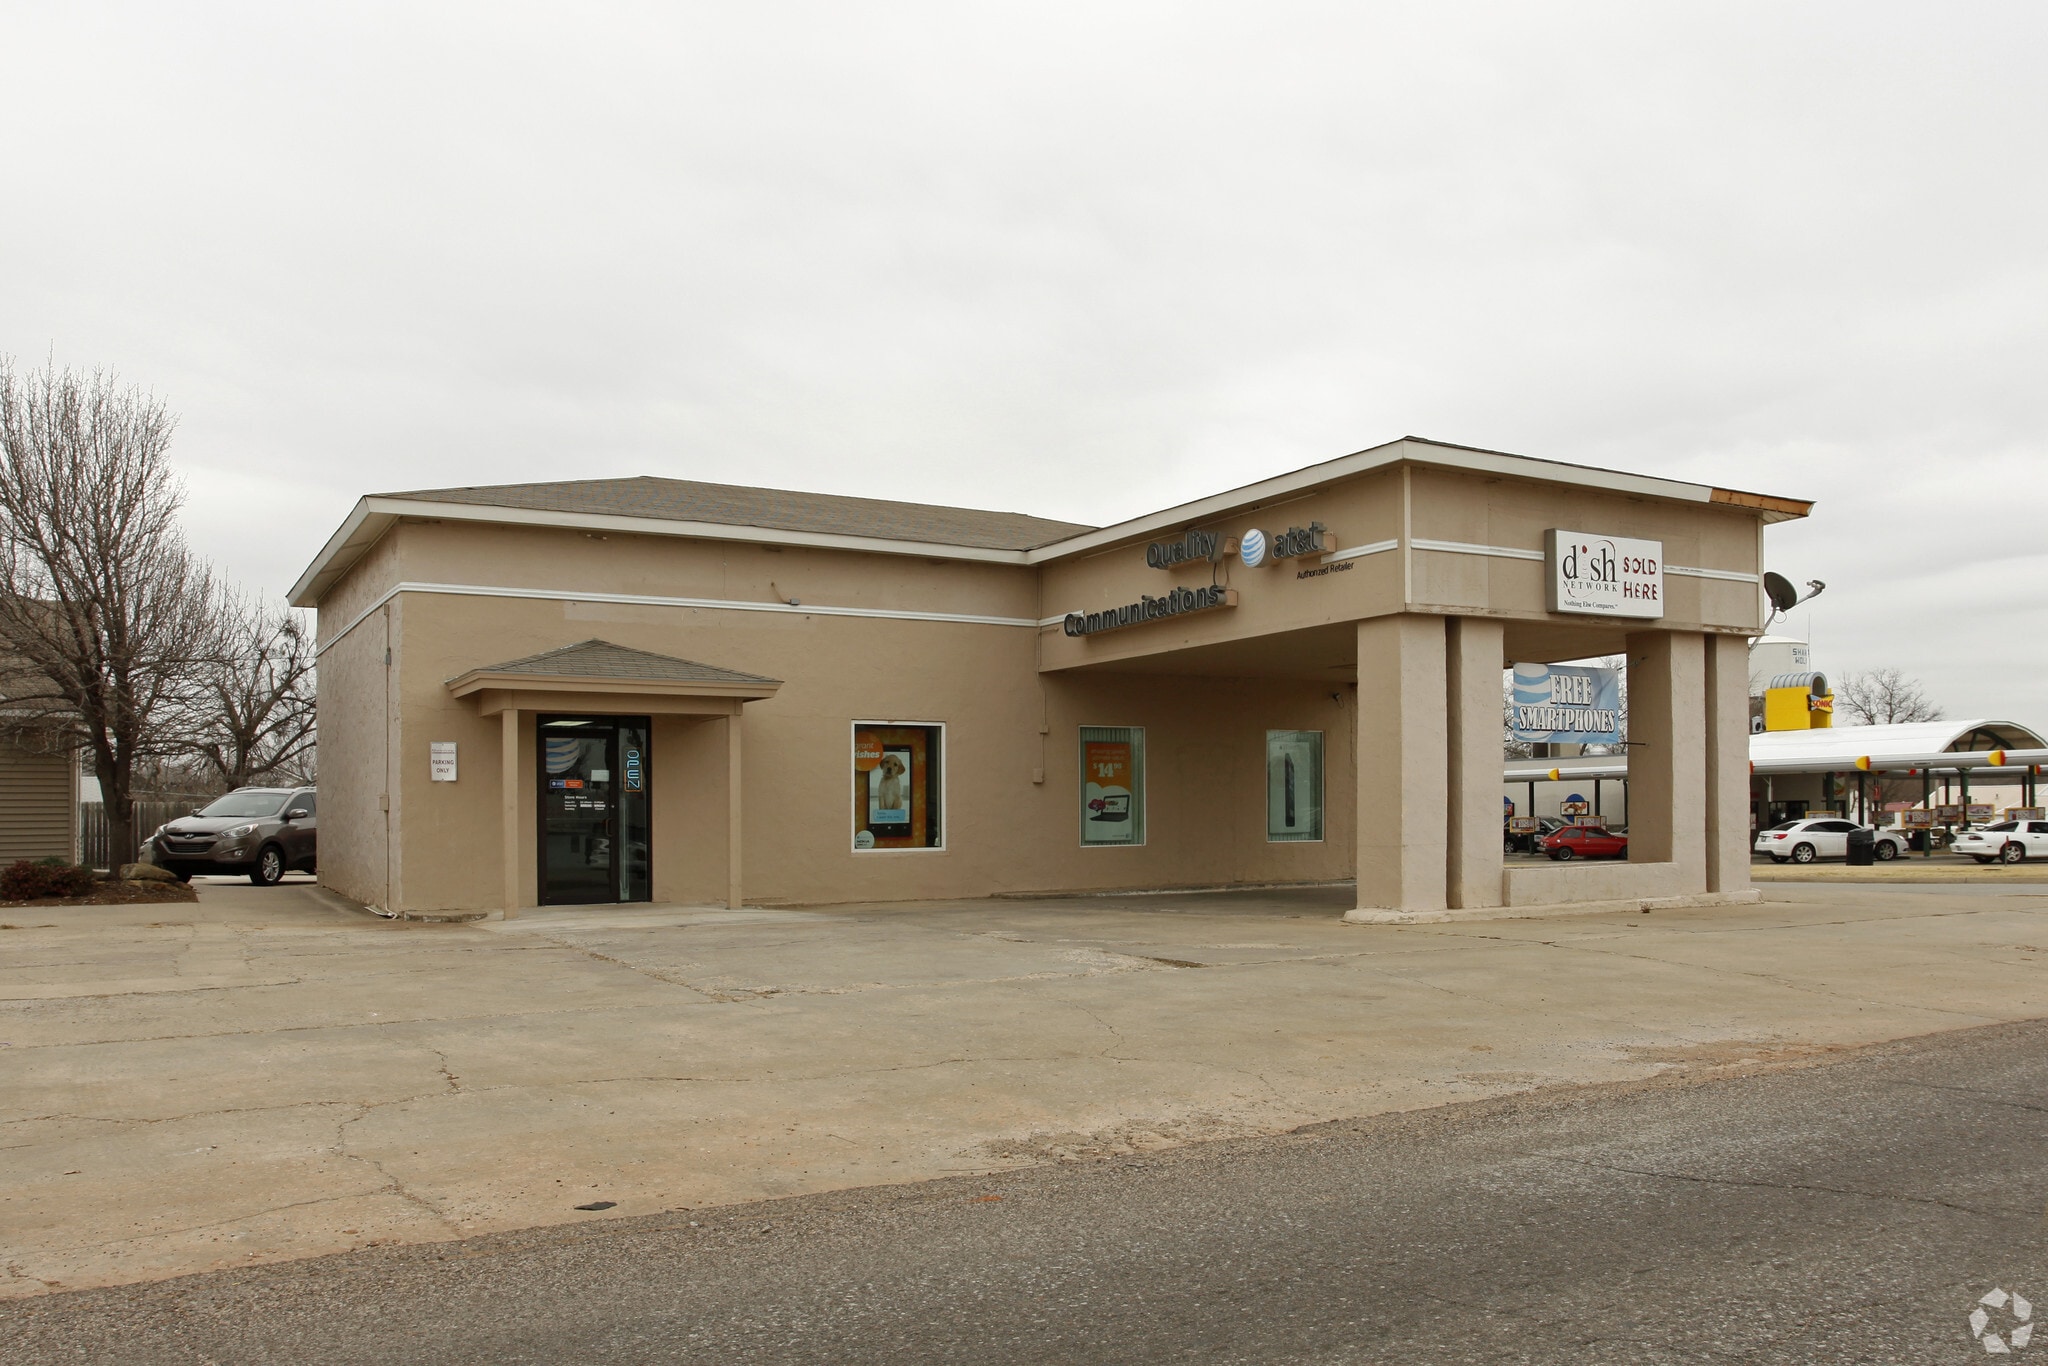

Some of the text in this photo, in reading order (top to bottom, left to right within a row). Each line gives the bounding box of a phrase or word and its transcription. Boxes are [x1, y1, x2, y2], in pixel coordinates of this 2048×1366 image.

[1146, 531, 1220, 569] Quality
[1271, 521, 1326, 558] at&t
[1297, 562, 1354, 579] Authorized Retailer
[1563, 545, 1618, 582] dish
[1623, 556, 1657, 576] SOLD
[1563, 580, 1618, 593] NETWORK
[1623, 581, 1658, 600] HERE
[1064, 584, 1222, 638] Communications
[1564, 600, 1582, 608] Nothing
[1549, 674, 1592, 706] FREE
[1812, 700, 1833, 708] SONIC
[1519, 706, 1616, 733] SMARTPHONES
[627, 750, 640, 789] OPEN
